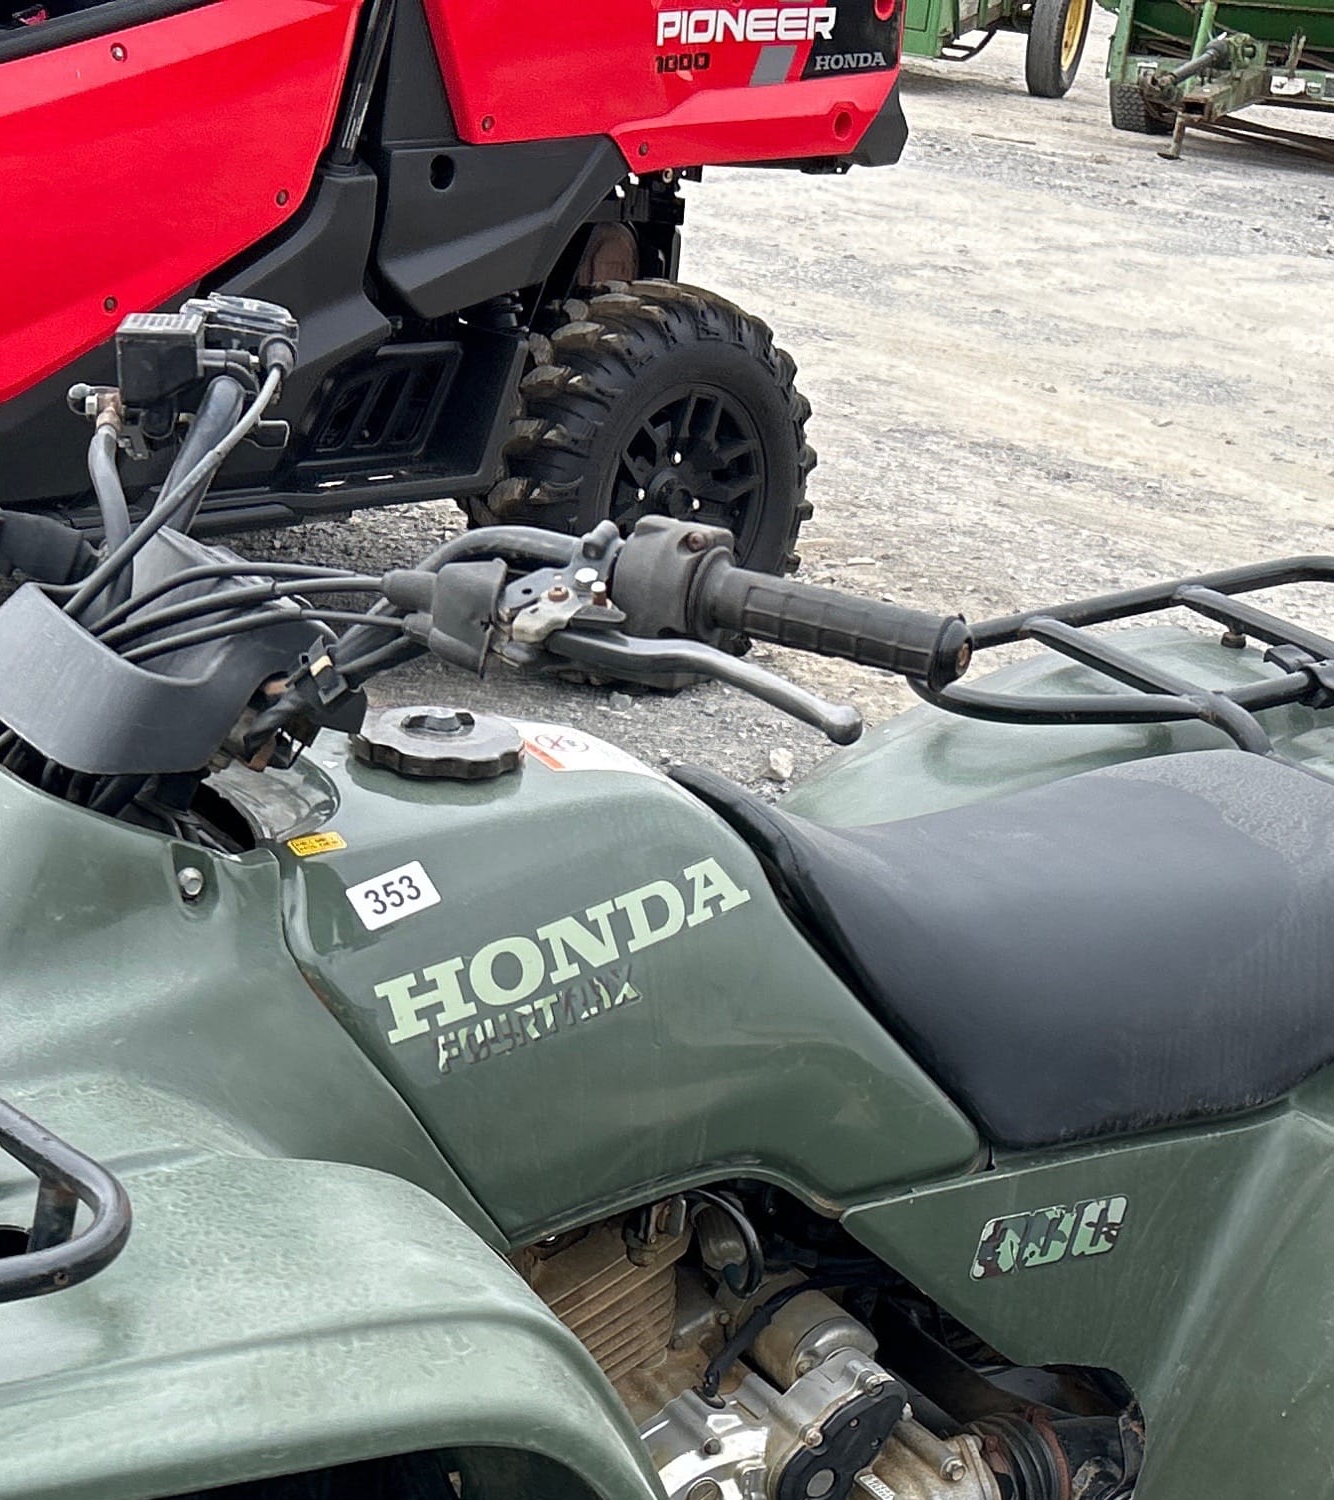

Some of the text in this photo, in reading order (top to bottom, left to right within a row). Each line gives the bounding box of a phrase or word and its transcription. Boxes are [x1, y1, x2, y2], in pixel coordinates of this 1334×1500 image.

[657, 8, 837, 46] PIONEER
[654, 52, 711, 74] 1000
[814, 51, 887, 71] HONDA
[364, 875, 422, 915] 353
[374, 857, 751, 1045] HONDA
